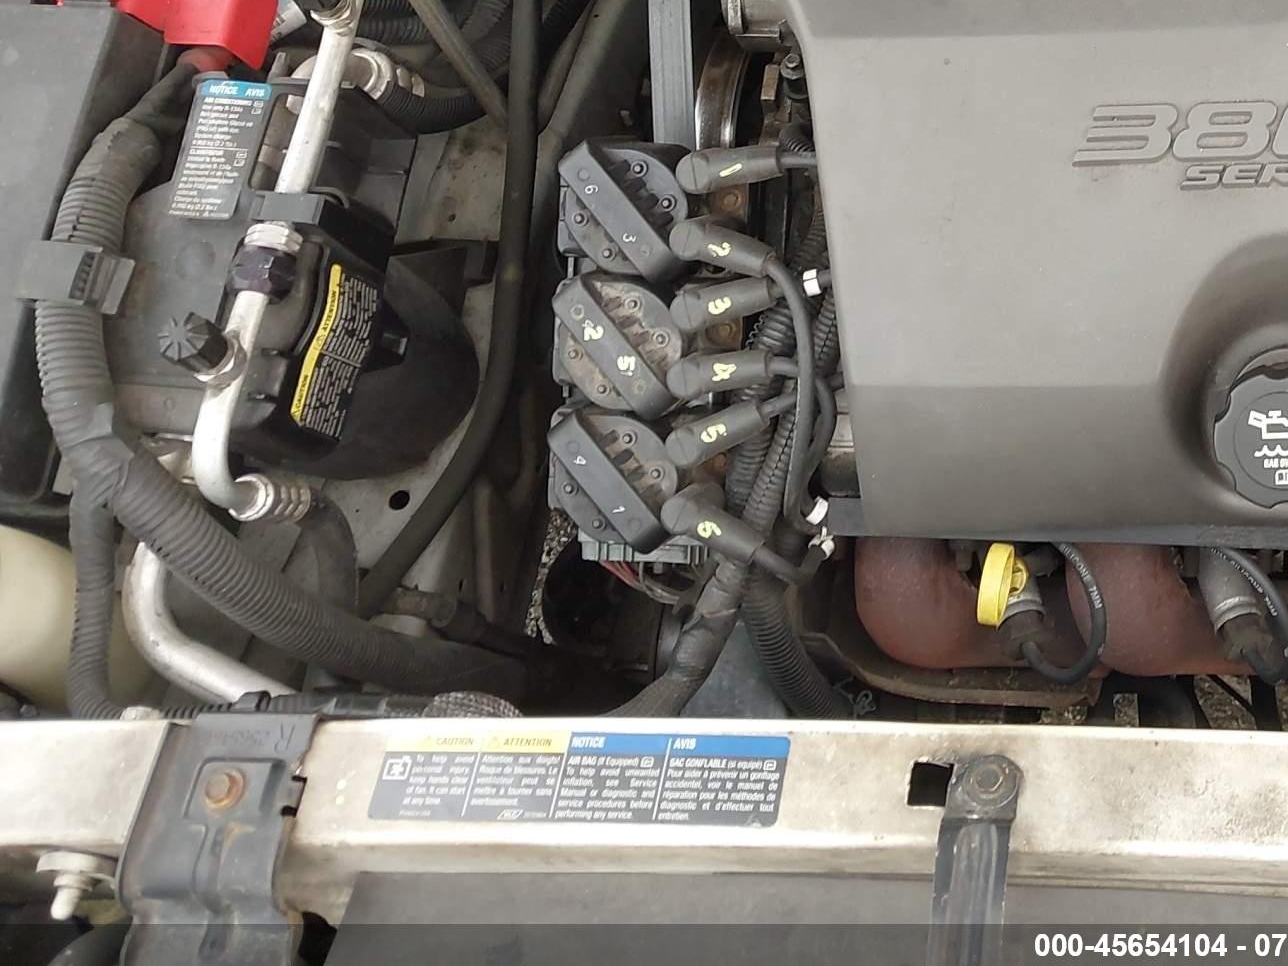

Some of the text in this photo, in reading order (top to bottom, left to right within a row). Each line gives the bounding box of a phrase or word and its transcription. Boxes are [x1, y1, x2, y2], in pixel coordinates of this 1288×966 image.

[209, 85, 265, 97] NOTICE AVIS
[622, 233, 637, 243] 3
[321, 289, 338, 331] ATTENTION
[295, 374, 309, 409] CAUTION
[436, 737, 474, 746] CAUTION
[503, 737, 552, 746] ATTENTION
[571, 736, 606, 748] NOTICE
[673, 738, 697, 749] AVIS
[581, 756, 597, 766] BAG
[669, 758, 684, 768] SAC
[566, 767, 575, 776] To
[666, 769, 683, 778] Pour
[629, 778, 657, 787] Service
